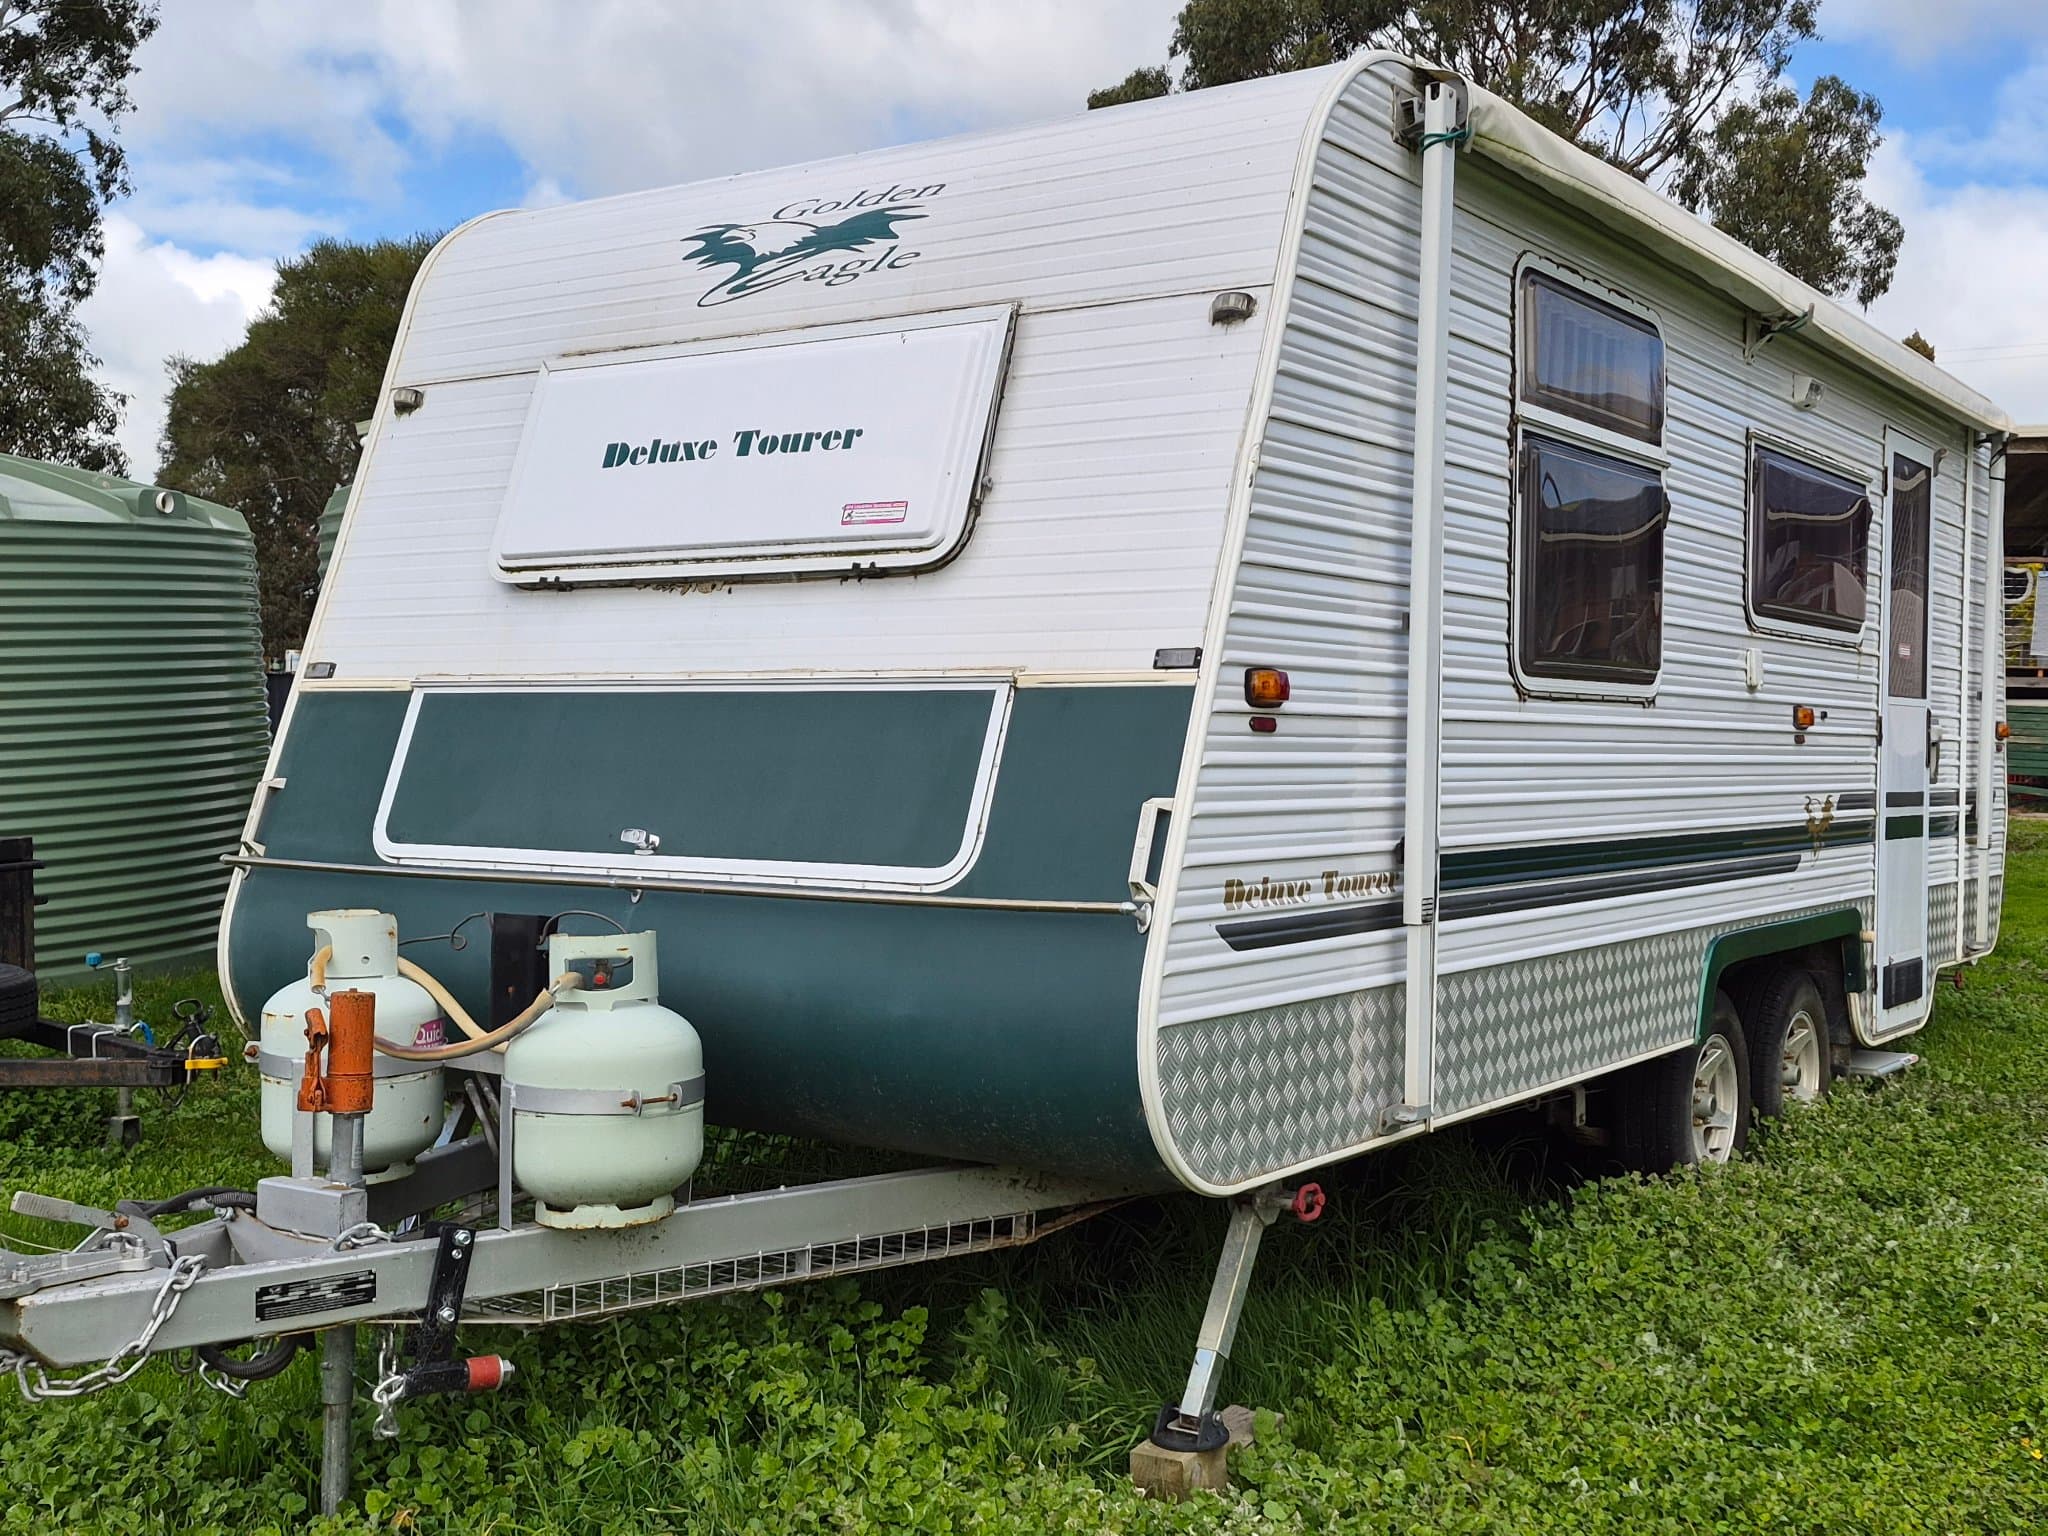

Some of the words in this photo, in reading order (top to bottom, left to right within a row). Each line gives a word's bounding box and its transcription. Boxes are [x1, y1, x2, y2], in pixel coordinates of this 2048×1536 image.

[773, 184, 946, 219] Golden
[697, 245, 921, 307] Eagle
[602, 438, 718, 469] Deluxe
[733, 428, 863, 457] Tourer
[1223, 877, 1312, 911] Deluxe
[1321, 870, 1400, 900] Tourer
